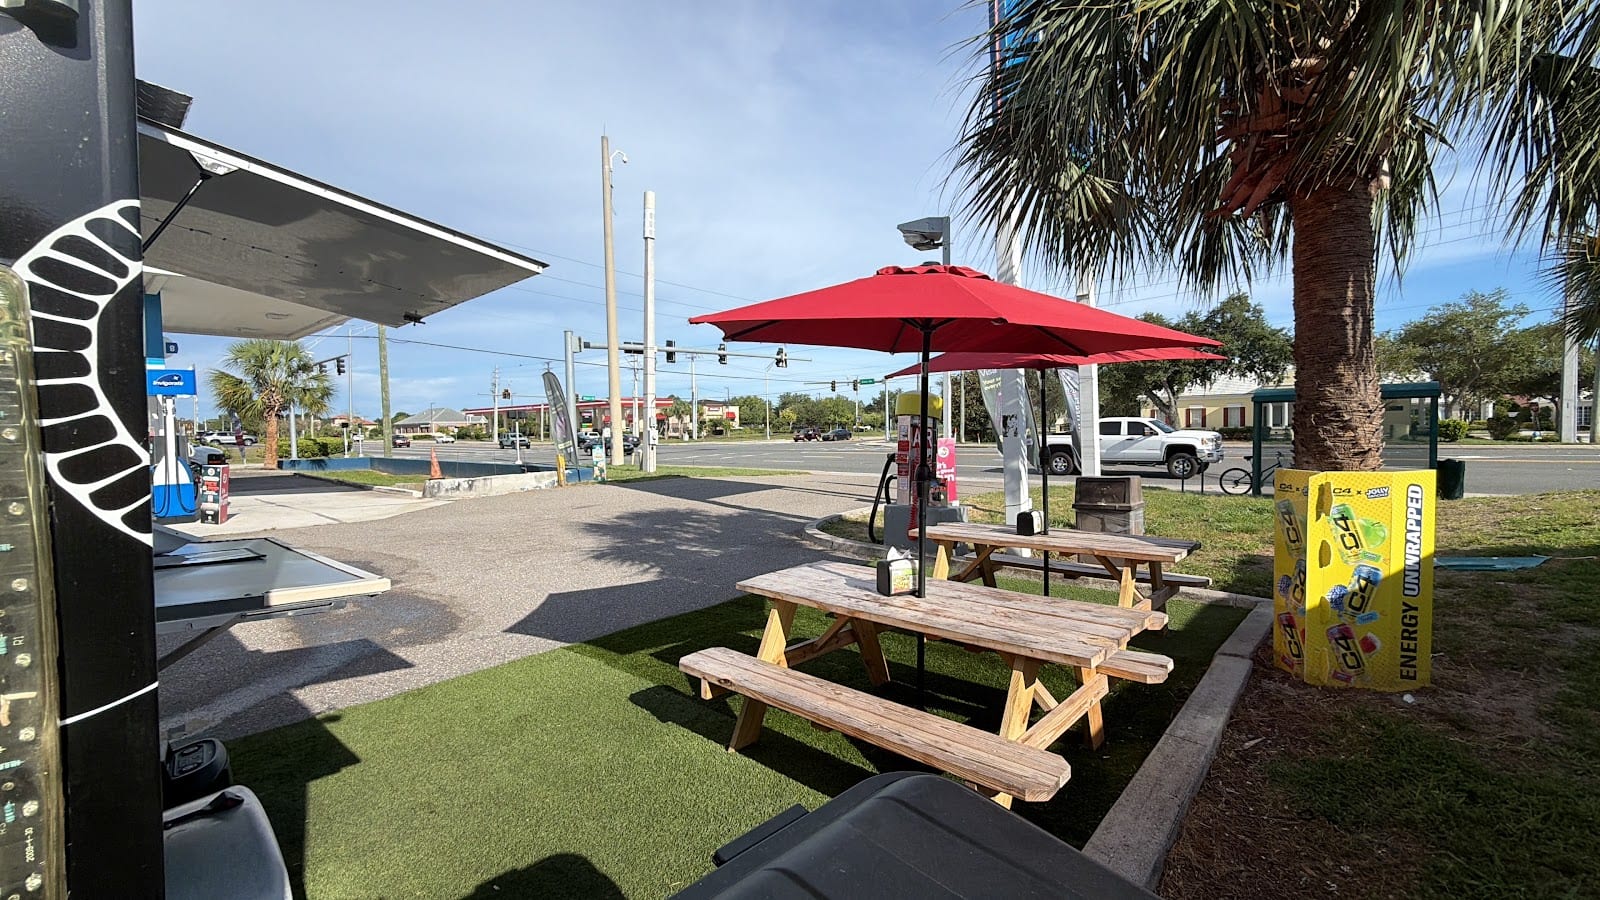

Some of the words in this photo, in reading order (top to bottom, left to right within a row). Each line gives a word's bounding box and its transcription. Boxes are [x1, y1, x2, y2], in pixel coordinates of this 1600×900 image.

[912, 427, 933, 448] AR
[1366, 486, 1389, 496] JOLLY
[1281, 509, 1300, 543] C4
[1333, 513, 1360, 550] C4
[1403, 483, 1423, 597] UNWRAPPED
[1348, 574, 1380, 612] C4
[1283, 622, 1302, 659] C4
[1334, 633, 1362, 669] C4
[1400, 601, 1419, 681] ENERGY
